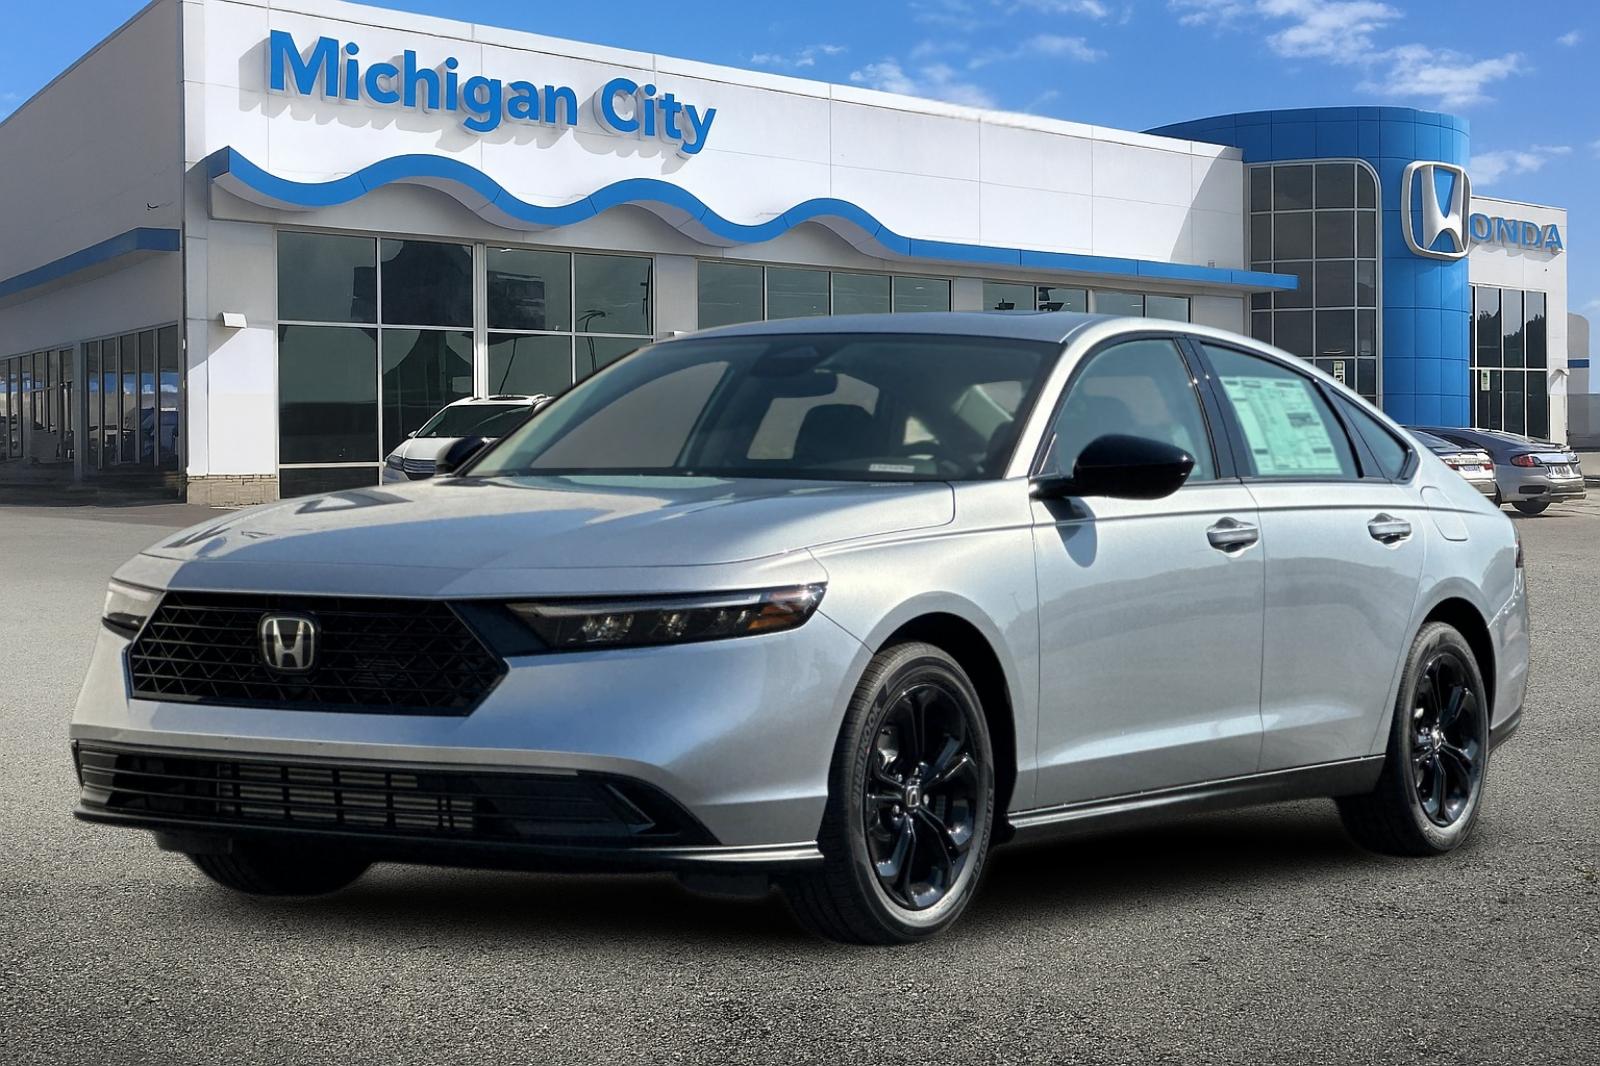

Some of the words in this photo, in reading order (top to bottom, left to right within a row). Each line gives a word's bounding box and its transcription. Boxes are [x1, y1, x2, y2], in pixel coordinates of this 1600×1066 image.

[269, 29, 578, 133] Michigan
[600, 78, 718, 155] City
[1470, 213, 1563, 250] ONDA
